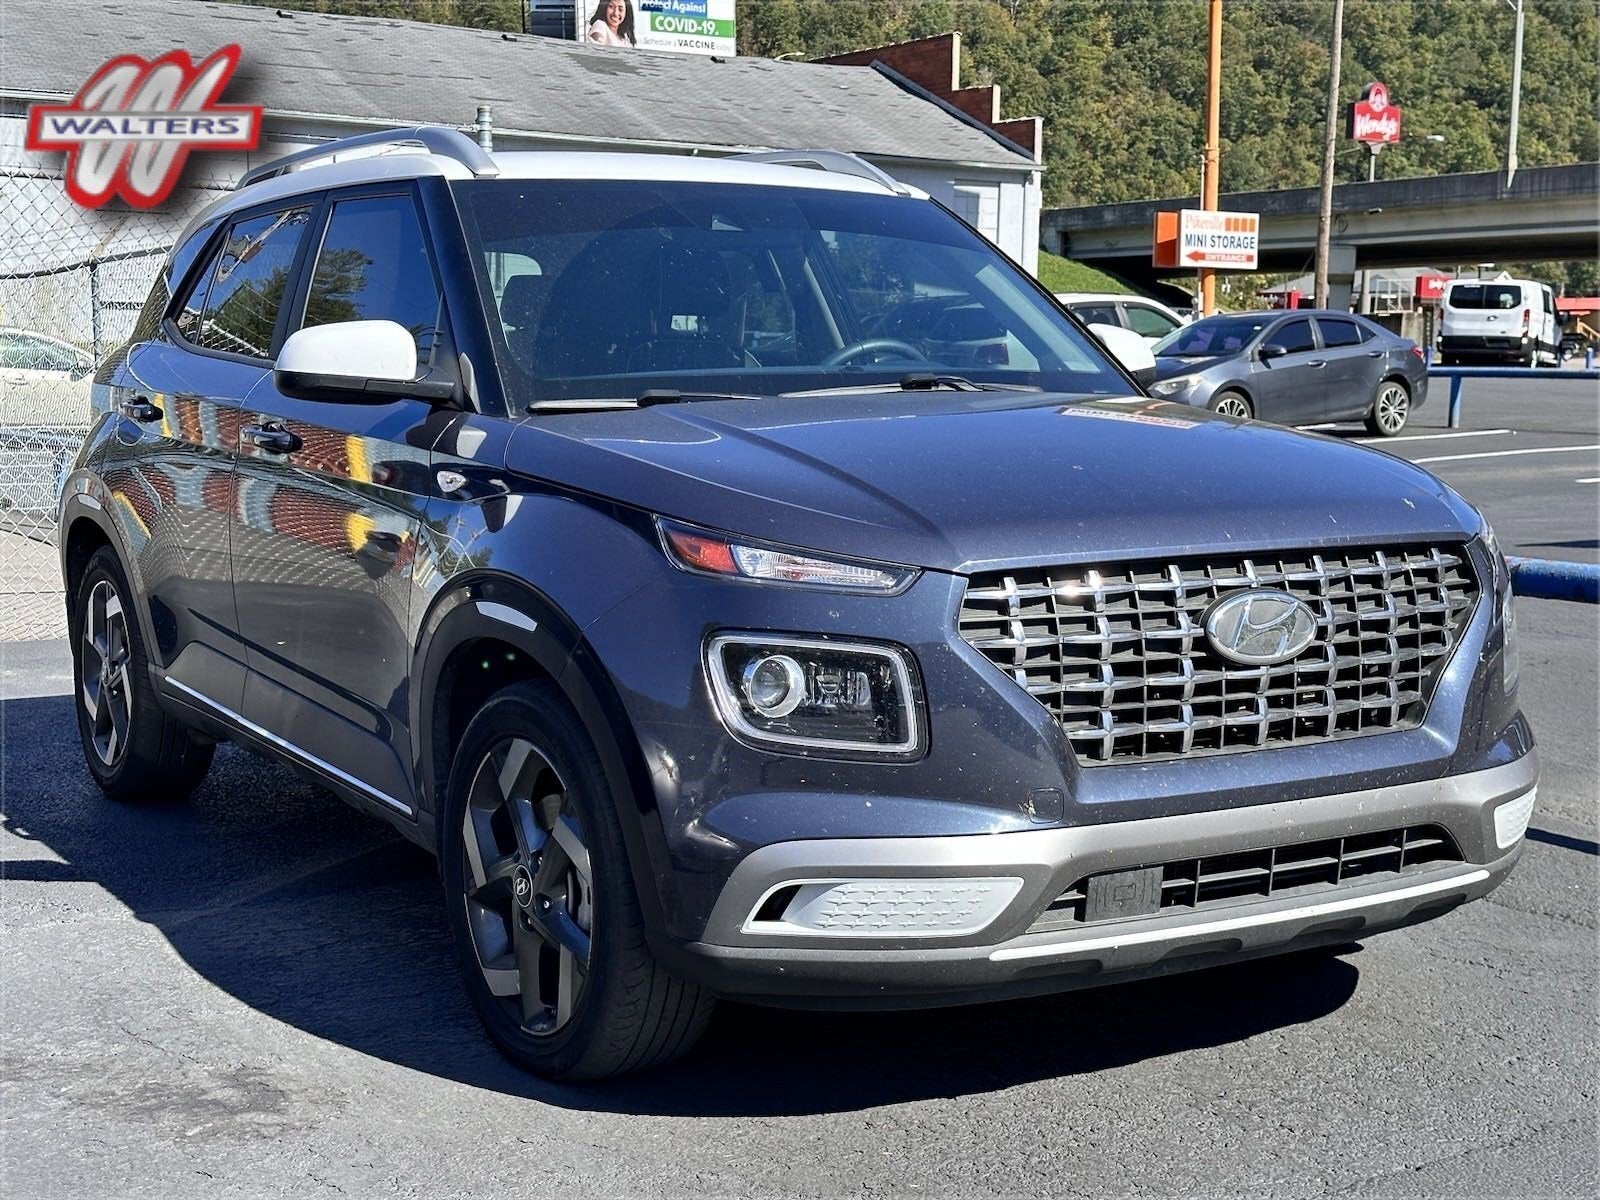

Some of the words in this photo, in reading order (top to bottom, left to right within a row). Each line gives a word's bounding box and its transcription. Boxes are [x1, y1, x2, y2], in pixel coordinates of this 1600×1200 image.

[672, 2, 705, 14] Against
[655, 16, 719, 36] COVID-19.
[677, 40, 716, 50] VACCINE
[1356, 111, 1398, 140] Wendy's
[1185, 233, 1207, 248] MINI
[1209, 235, 1255, 249] STORAGE
[1205, 252, 1247, 263] ENTRANCE
